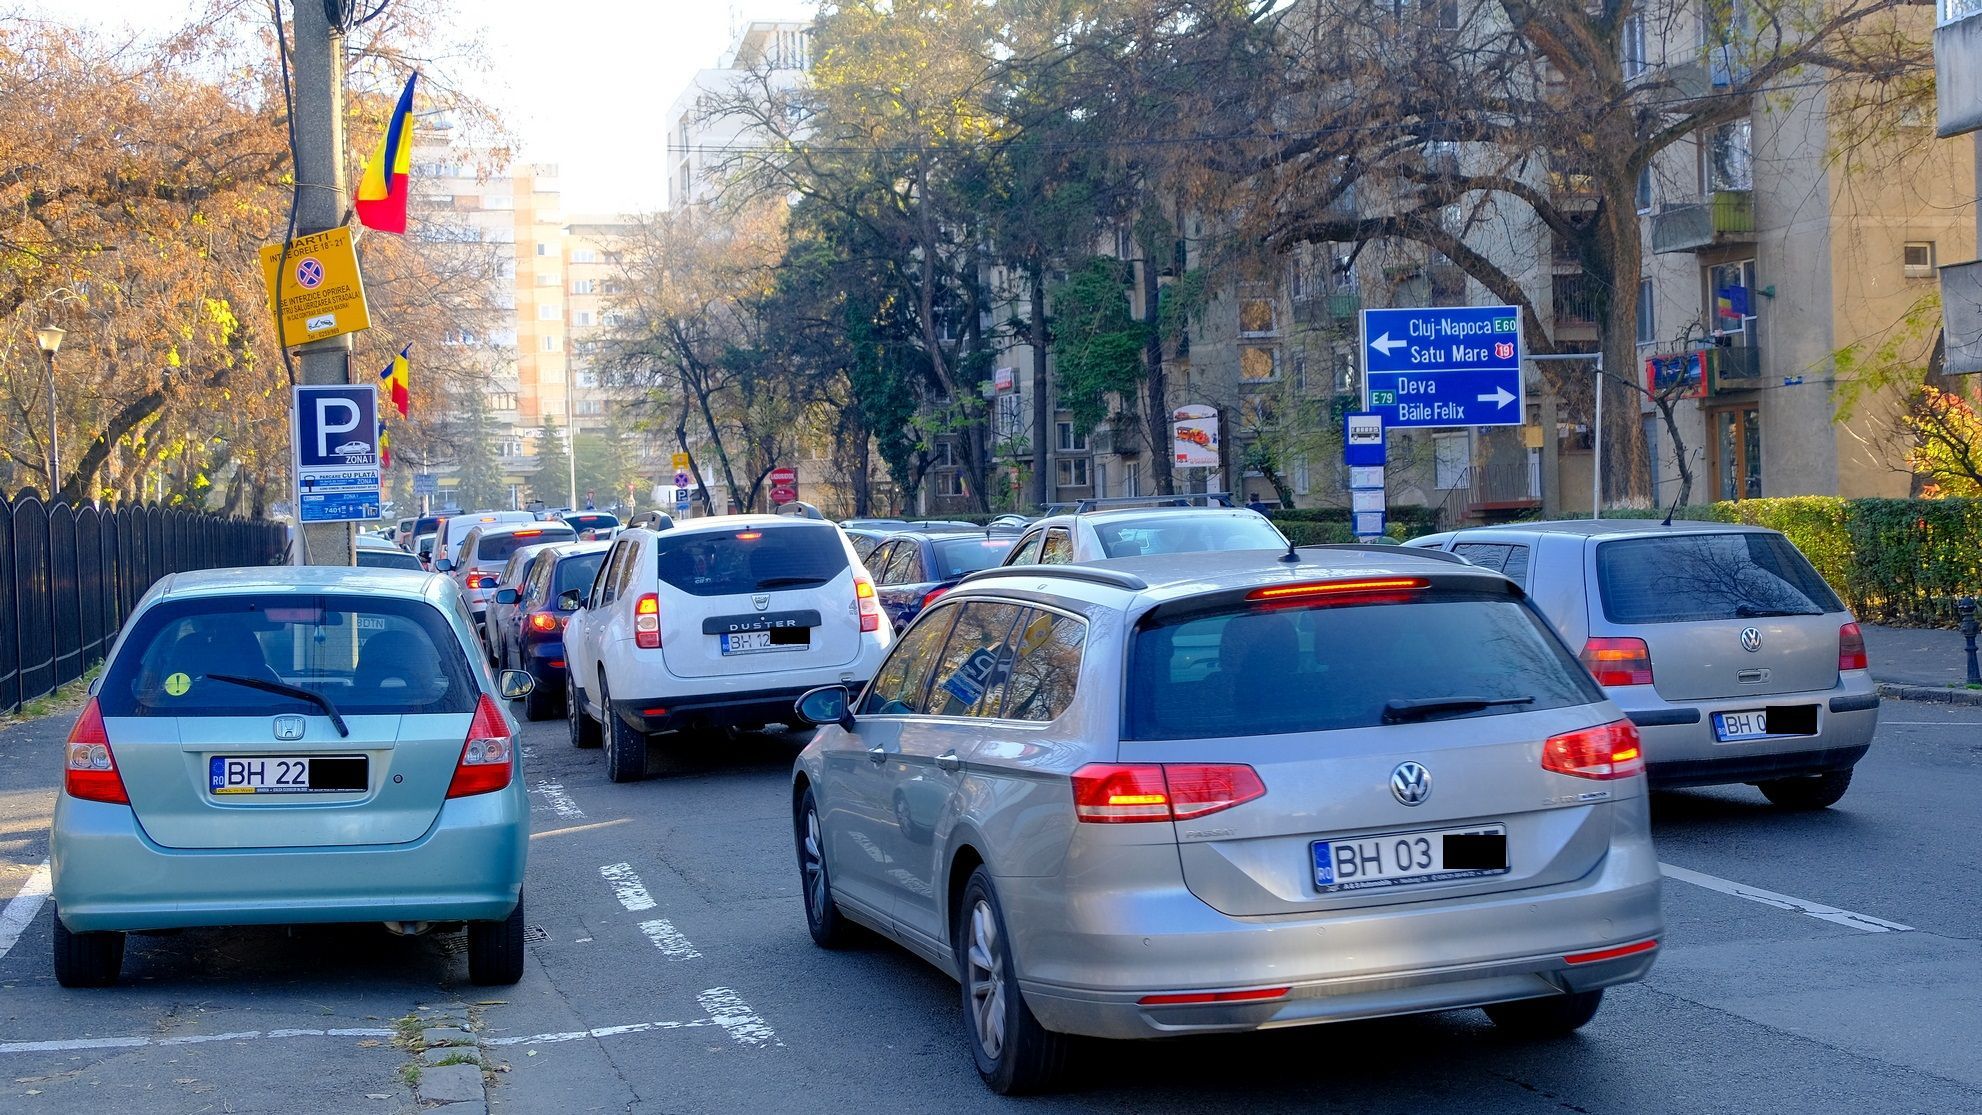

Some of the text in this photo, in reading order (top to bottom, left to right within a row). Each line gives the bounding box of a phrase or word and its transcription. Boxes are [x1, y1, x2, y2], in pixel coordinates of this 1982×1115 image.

[269, 250, 292, 262] INTE
[293, 245, 319, 257] ORELE
[289, 292, 321, 306] INTERZICE
[322, 285, 350, 298] OPRIREA
[294, 299, 332, 312] SALUBRIZAREA
[1409, 318, 1492, 340] Cluj-Napoca
[1411, 345, 1510, 363] Satu Mare 19
[1398, 377, 1436, 395] Deva
[1400, 402, 1465, 421] Băile Felix
[316, 397, 361, 457] P
[345, 455, 369, 464] ZONA
[678, 490, 686, 500] P
[729, 619, 797, 631] DUSTER
[730, 635, 751, 650] BH
[757, 634, 770, 647] 12
[1726, 715, 1752, 734] BH
[212, 761, 306, 786] RO BH 22
[1317, 837, 1432, 880] RO BH 03
